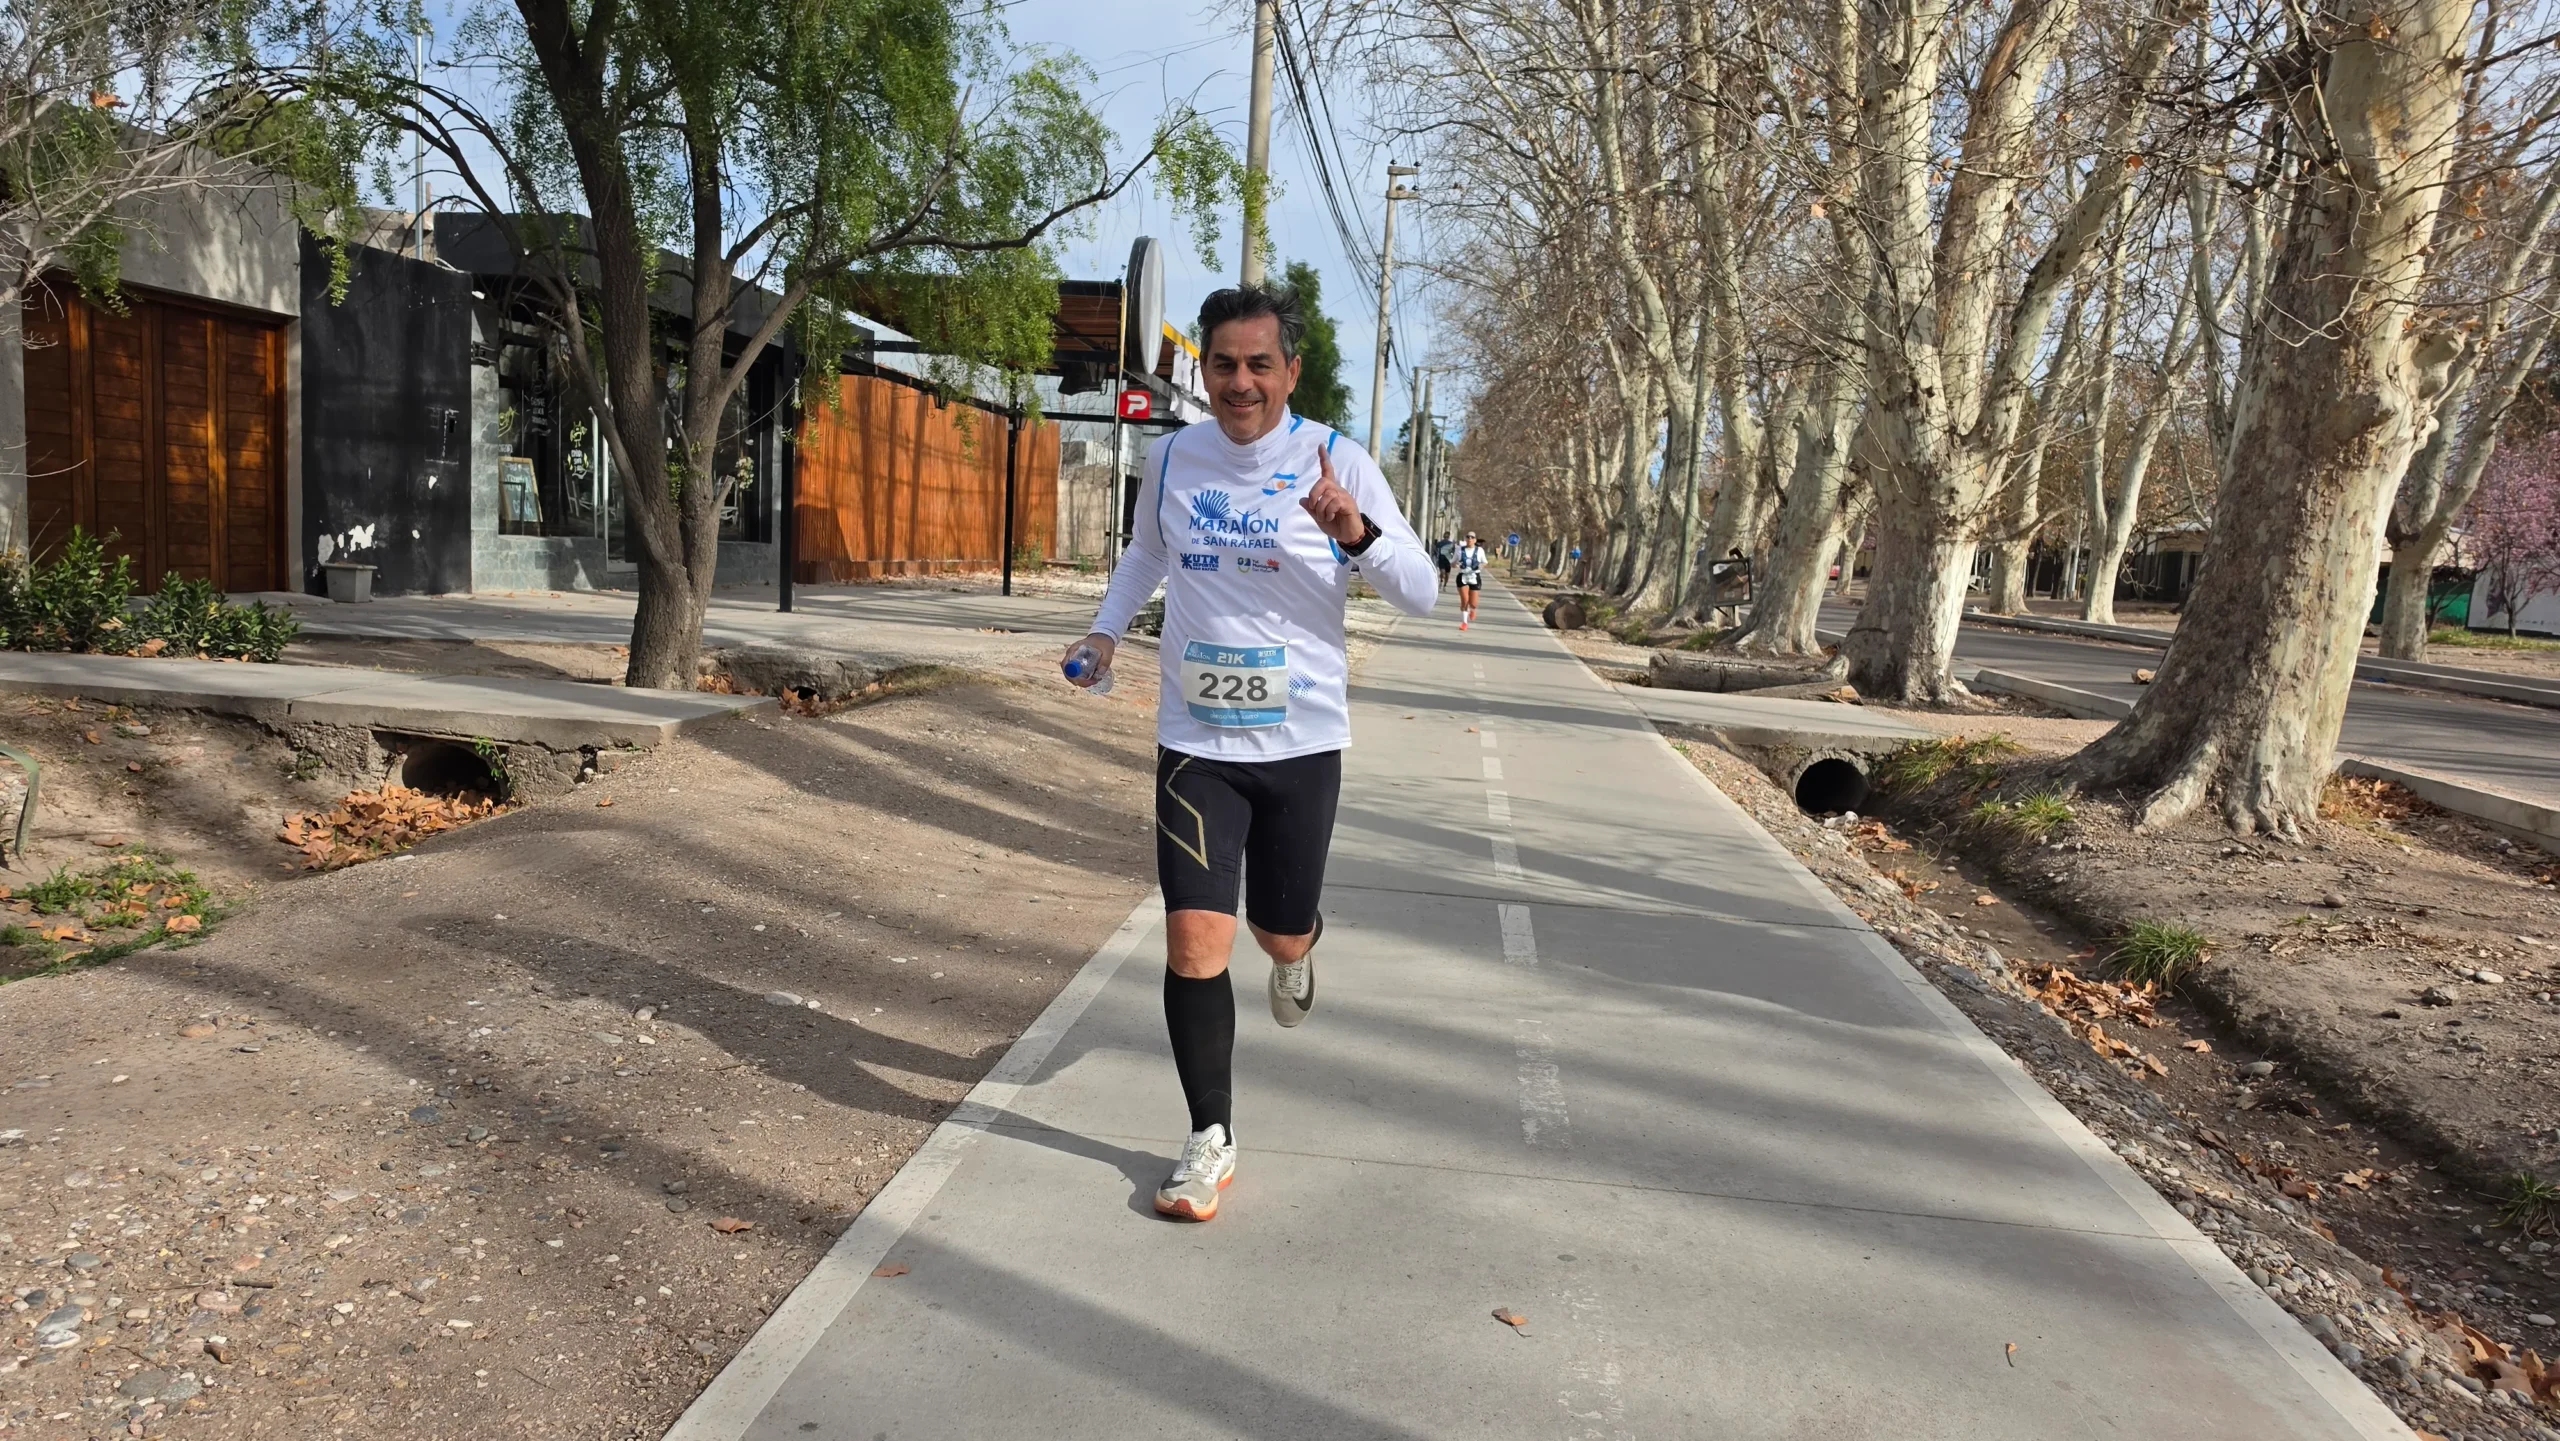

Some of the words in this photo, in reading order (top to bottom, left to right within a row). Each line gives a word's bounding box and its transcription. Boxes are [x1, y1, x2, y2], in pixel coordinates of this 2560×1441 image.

[1203, 536, 1227, 547] SAN
[1230, 538, 1277, 548] RAFAEL
[1193, 554, 1219, 564] UTN
[1217, 652, 1246, 665] 21K
[1198, 672, 1269, 702] 228
